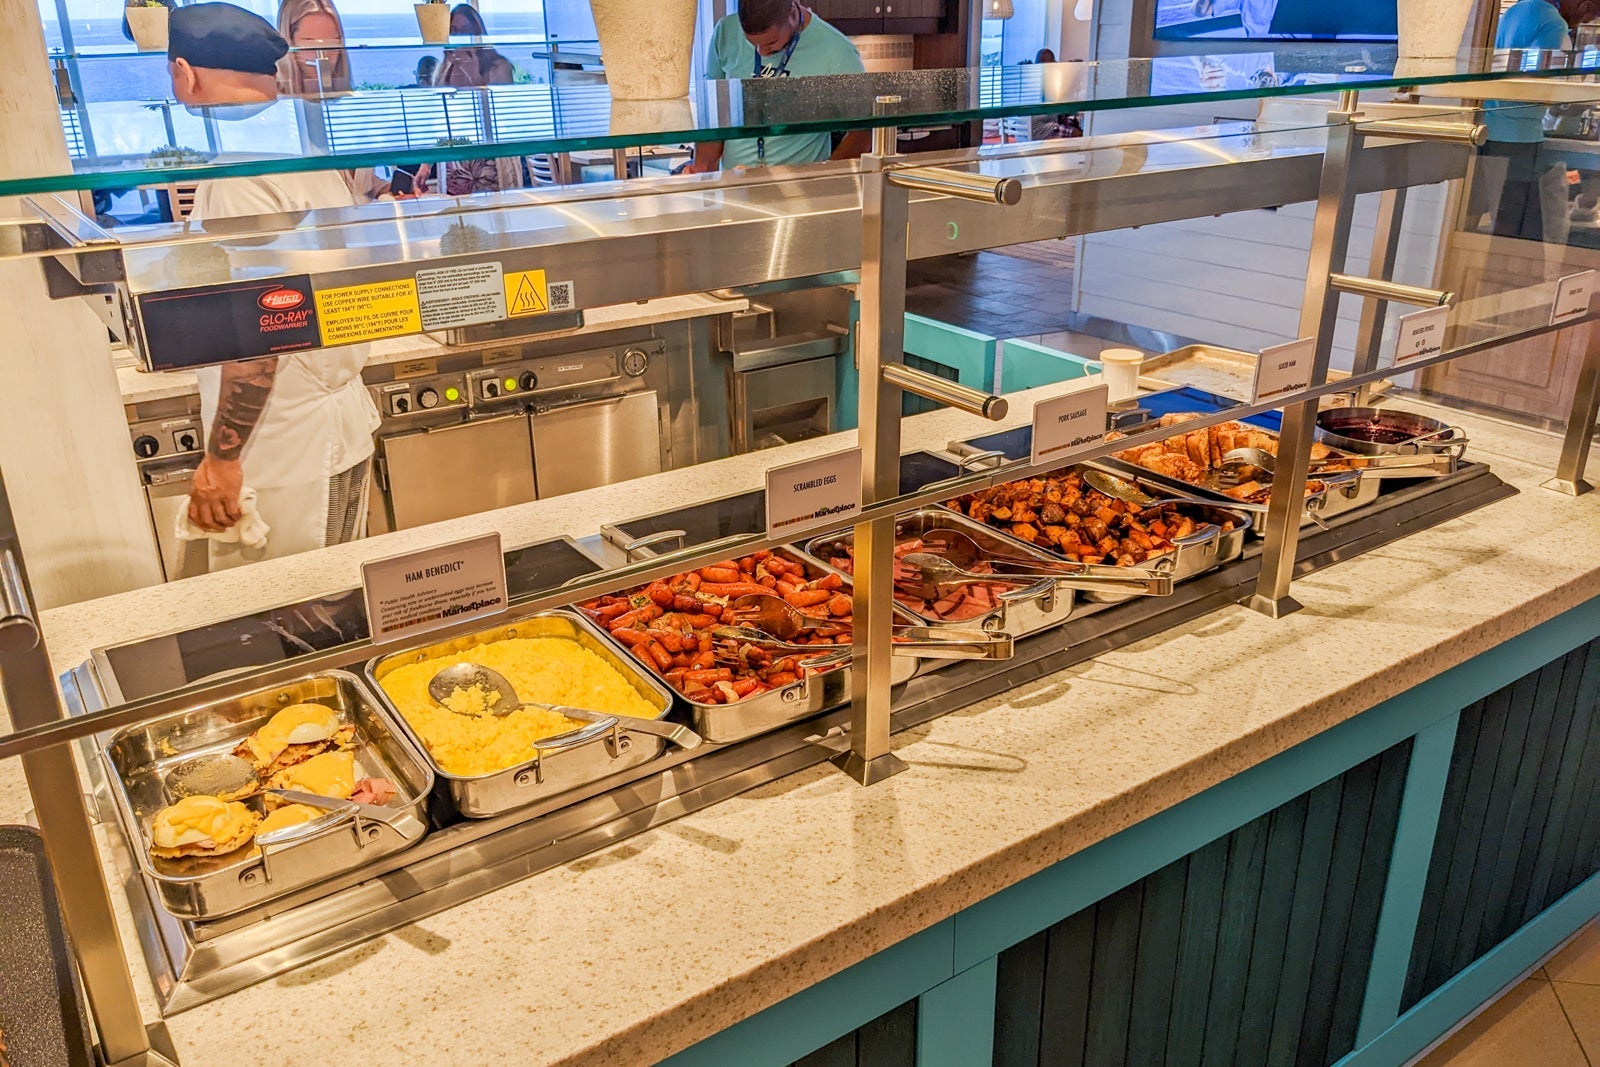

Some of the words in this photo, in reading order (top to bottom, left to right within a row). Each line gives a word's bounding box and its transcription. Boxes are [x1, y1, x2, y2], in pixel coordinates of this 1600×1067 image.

[334, 298, 356, 306] COPPER
[371, 292, 395, 300] SUITABLE
[354, 288, 373, 296] SUPPLY
[263, 294, 301, 305] Hatco
[326, 317, 355, 326] EMPLOYER
[380, 310, 398, 318] CUIVRE
[260, 321, 308, 333] FOODWARMER
[336, 324, 352, 332] MOINS
[328, 329, 362, 341] CONNEXIONS
[1058, 414, 1070, 423] PORK
[1070, 409, 1087, 420] SAUSAGE
[793, 479, 822, 492] SCRAMBLED
[824, 475, 836, 485] EGGS
[815, 503, 855, 518] Marketplace
[405, 570, 424, 583] HAM
[380, 604, 407, 614] Consuming
[424, 590, 454, 602] undercooked
[454, 588, 464, 596] eggs
[384, 598, 398, 606] Public
[400, 594, 416, 602] Health
[416, 588, 438, 598] Advisory
[450, 592, 472, 604] especially
[442, 597, 502, 618] Marketplace
